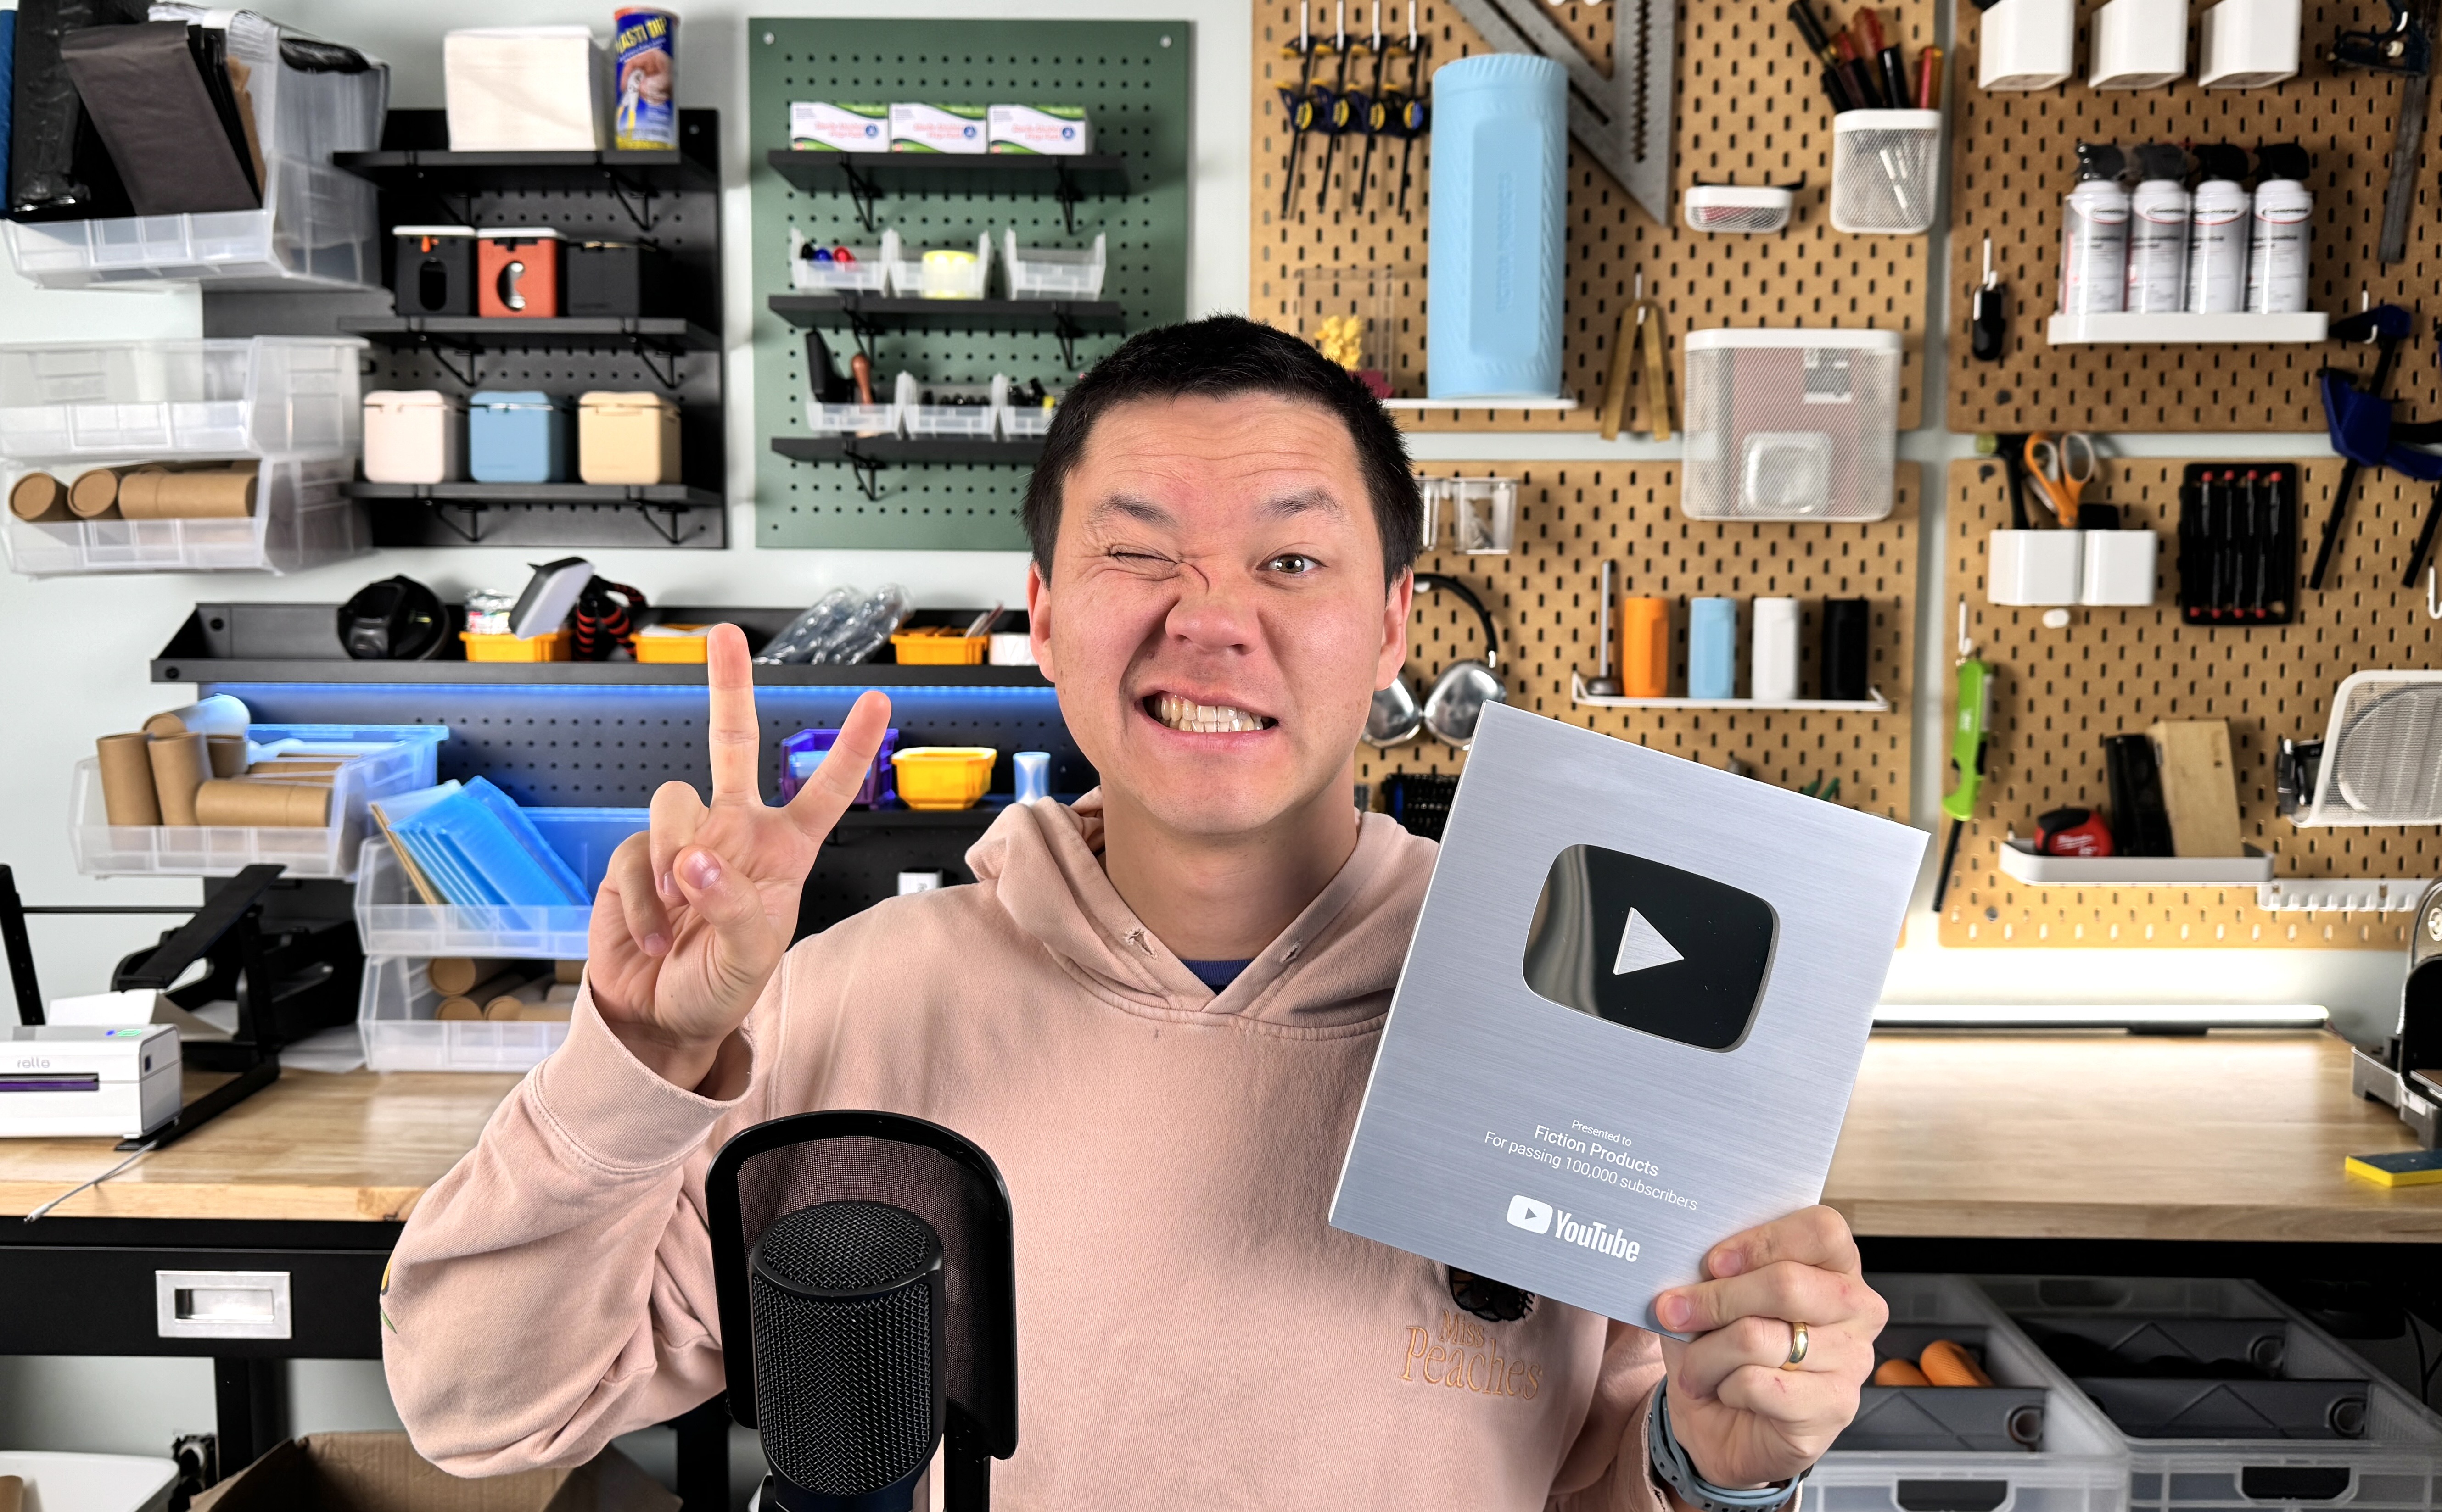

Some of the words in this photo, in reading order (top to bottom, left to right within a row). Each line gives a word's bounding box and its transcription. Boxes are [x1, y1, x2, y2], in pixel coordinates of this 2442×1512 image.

[17, 1056, 50, 1068] rollo
[1534, 1124, 1586, 1153] Fiction
[1589, 1142, 1659, 1177] Products
[1572, 1119, 1621, 1143] Presented
[1622, 1136, 1632, 1147] to
[1484, 1131, 1508, 1148] For
[1508, 1142, 1562, 1169] passing
[1566, 1156, 1618, 1184] 100,000
[1619, 1177, 1698, 1210] subscribers
[1555, 1210, 1640, 1262] YouTube
[1439, 1309, 1484, 1348] Miss
[1399, 1325, 1542, 1400] Peaches
